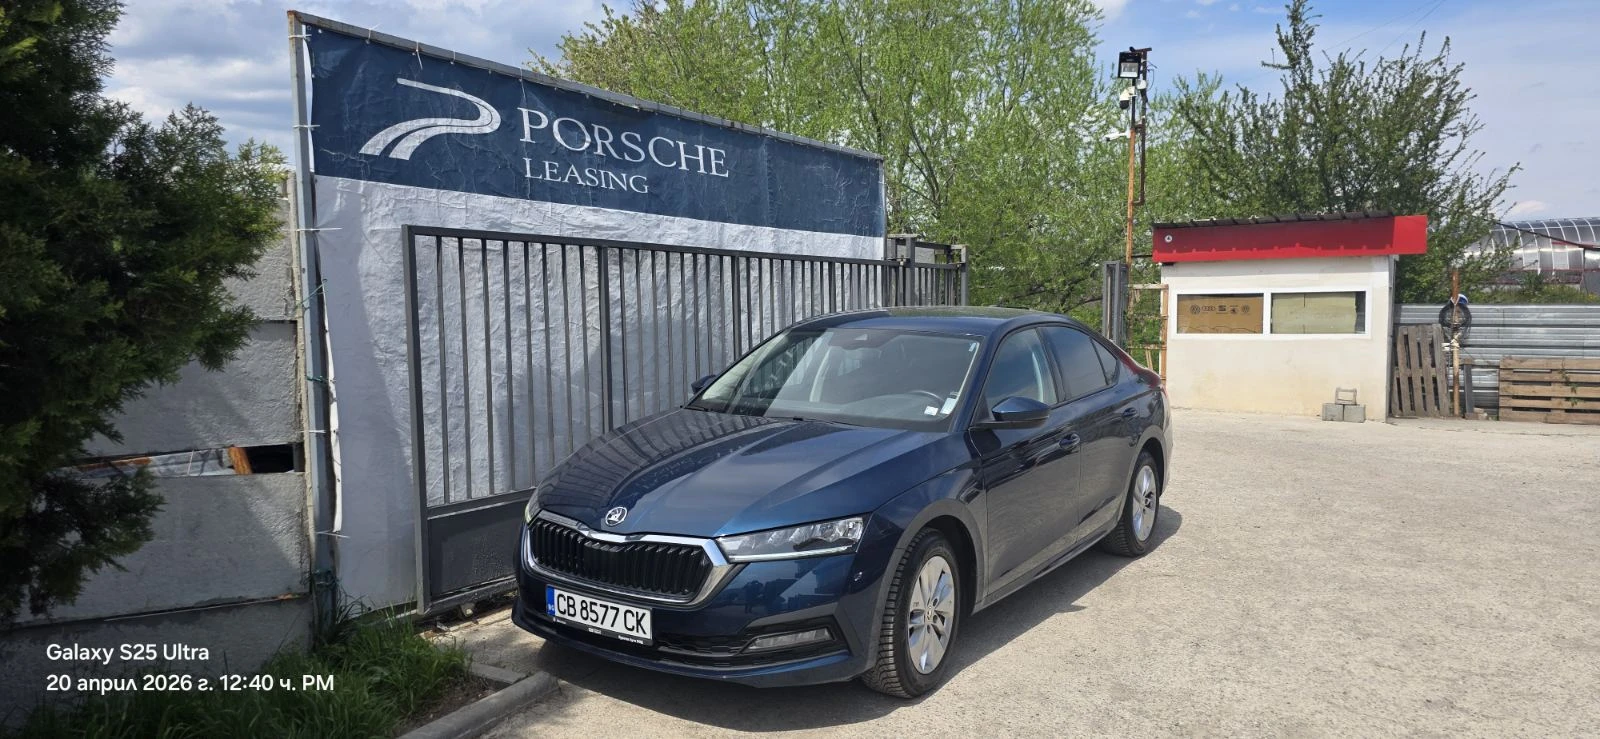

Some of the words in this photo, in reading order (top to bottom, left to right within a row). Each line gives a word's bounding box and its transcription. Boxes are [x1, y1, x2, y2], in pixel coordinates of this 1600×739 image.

[517, 107, 730, 178] PORSCHE
[522, 157, 649, 194] LEASING
[557, 593, 577, 618] CB
[580, 599, 620, 628] 8577
[624, 609, 647, 635] CK
